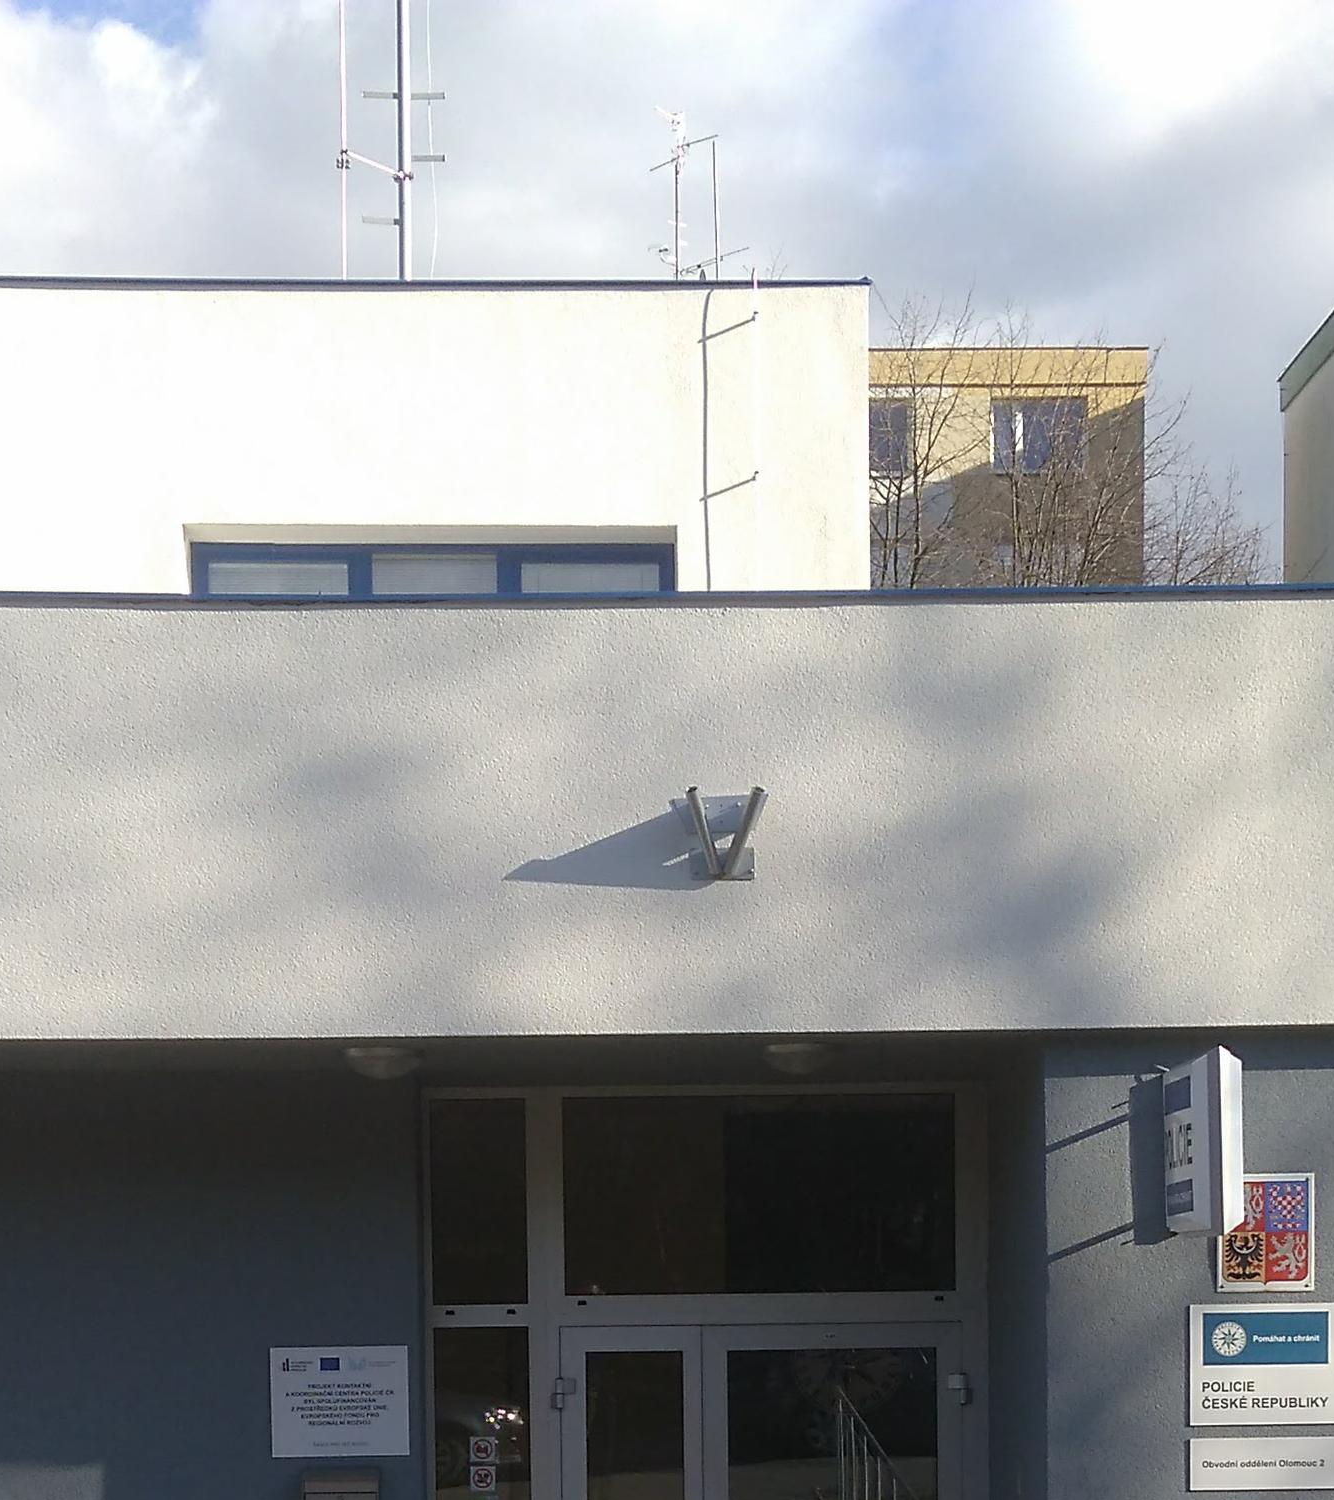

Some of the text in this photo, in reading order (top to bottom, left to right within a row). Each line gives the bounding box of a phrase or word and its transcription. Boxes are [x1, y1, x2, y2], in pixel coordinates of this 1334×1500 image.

[1253, 1335, 1286, 1343] Pomáhat
[1293, 1334, 1320, 1342] chránit
[1201, 1381, 1255, 1393] POLICIE
[1201, 1395, 1329, 1409] ČESKÉ REPUBLIKY
[1202, 1459, 1325, 1469] Obvodní oddělení Olomouc 2
